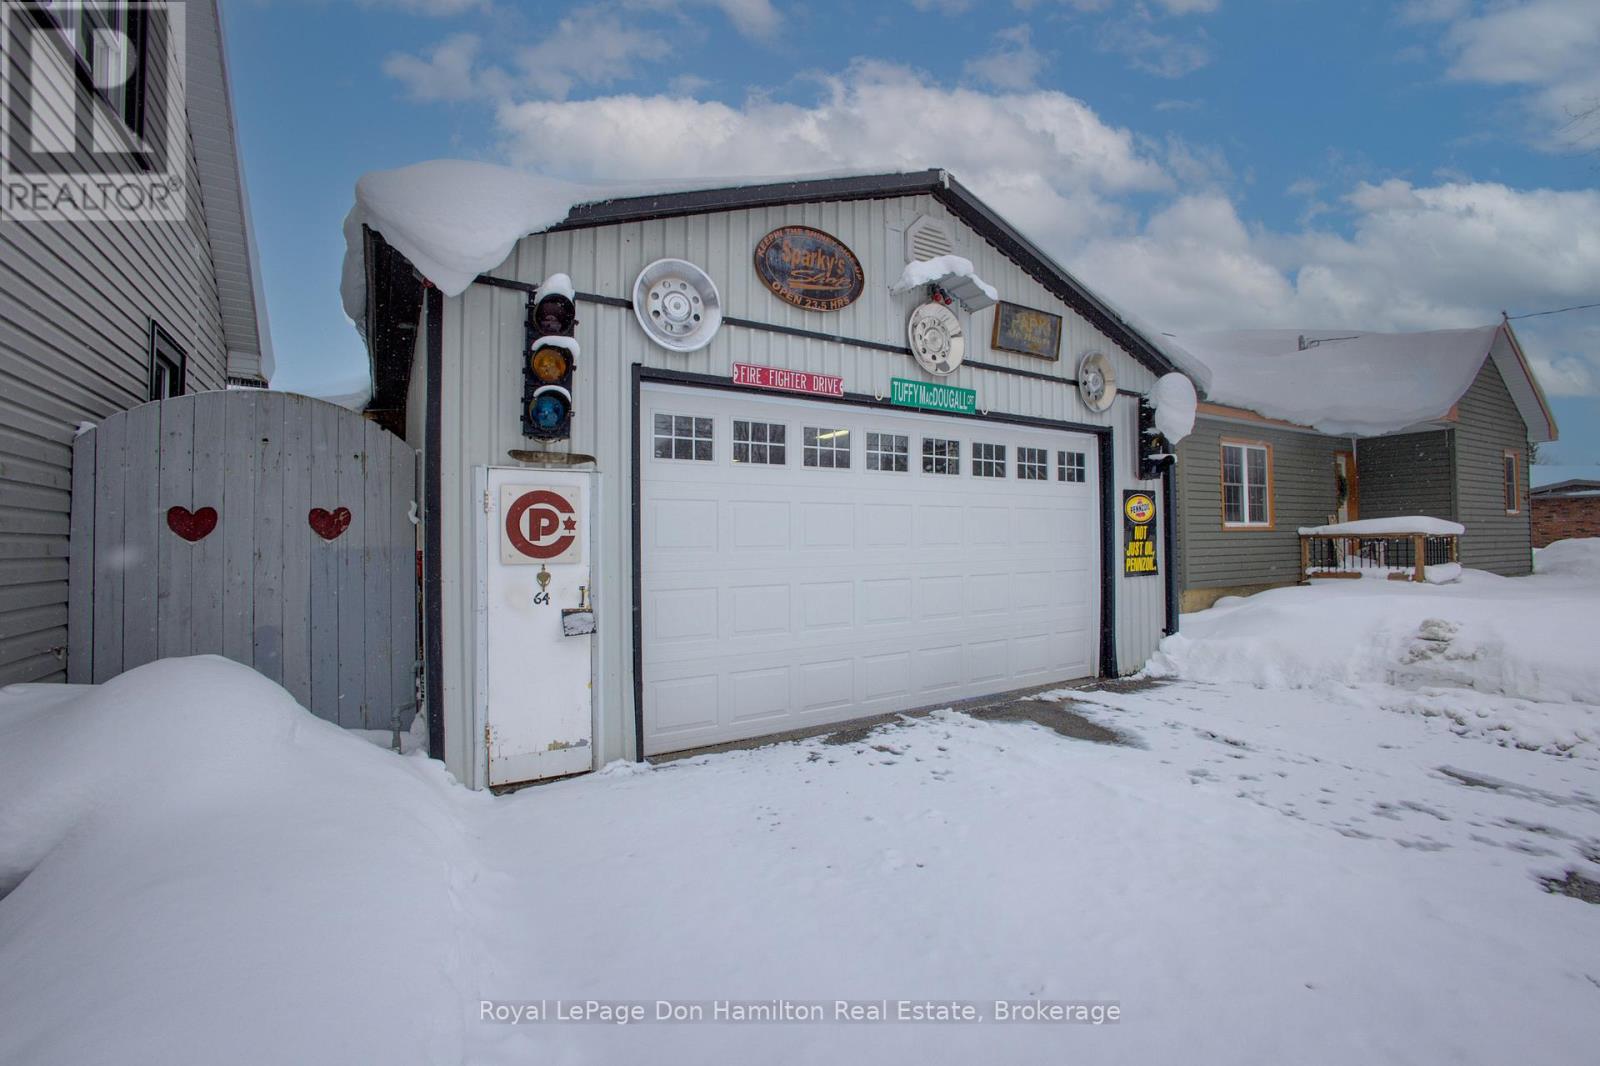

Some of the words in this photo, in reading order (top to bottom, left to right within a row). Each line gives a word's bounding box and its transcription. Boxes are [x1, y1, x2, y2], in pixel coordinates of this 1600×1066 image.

[782, 239, 846, 277] Sparky's
[772, 281, 802, 305] OPEN
[830, 296, 850, 310] HRS
[740, 366, 762, 384] FIRE
[769, 369, 807, 390] FIGHTER
[813, 375, 839, 394] DRIVE
[893, 381, 919, 403] TUFFY
[1134, 525, 1148, 540] NOT
[1126, 541, 1144, 556] JUST
[533, 592, 550, 605] 64
